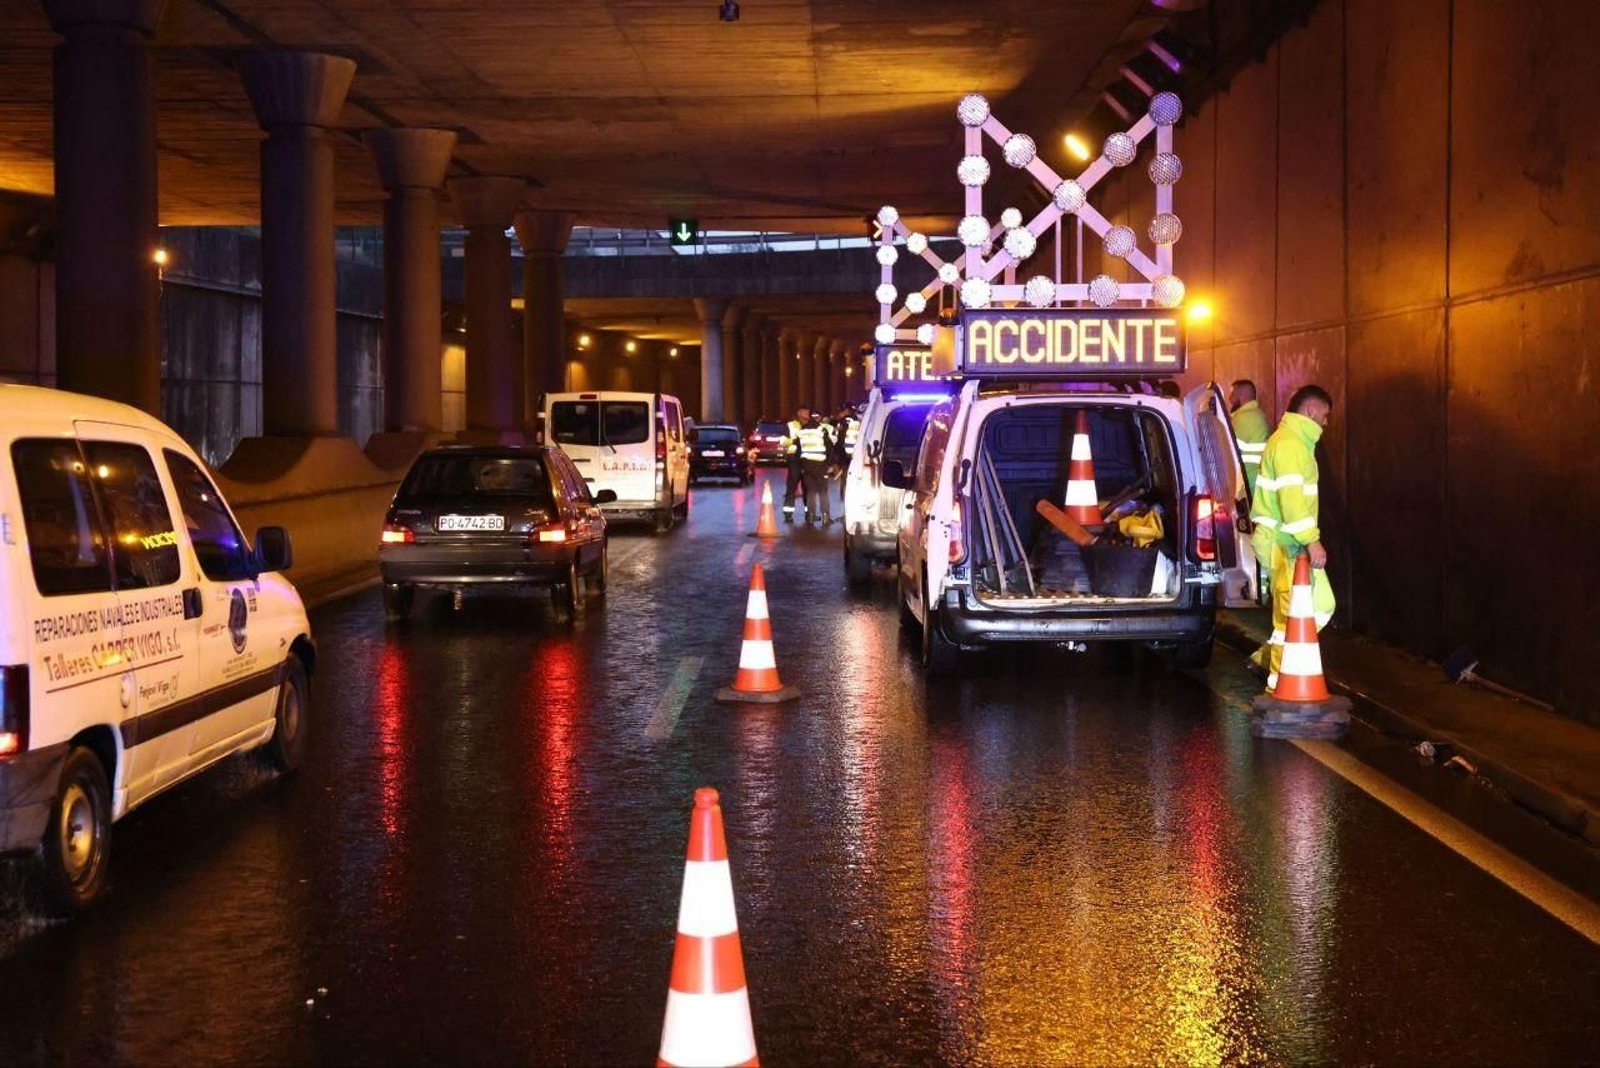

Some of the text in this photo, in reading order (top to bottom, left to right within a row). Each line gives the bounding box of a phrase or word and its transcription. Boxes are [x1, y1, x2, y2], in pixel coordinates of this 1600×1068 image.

[969, 318, 1177, 364] ACCIDENTE
[887, 351, 950, 381] ATE
[34, 610, 98, 642] REPARACIONES
[100, 604, 134, 630] NAVALES
[140, 594, 183, 622] INDUSTRIALES
[43, 652, 95, 681] Talleres
